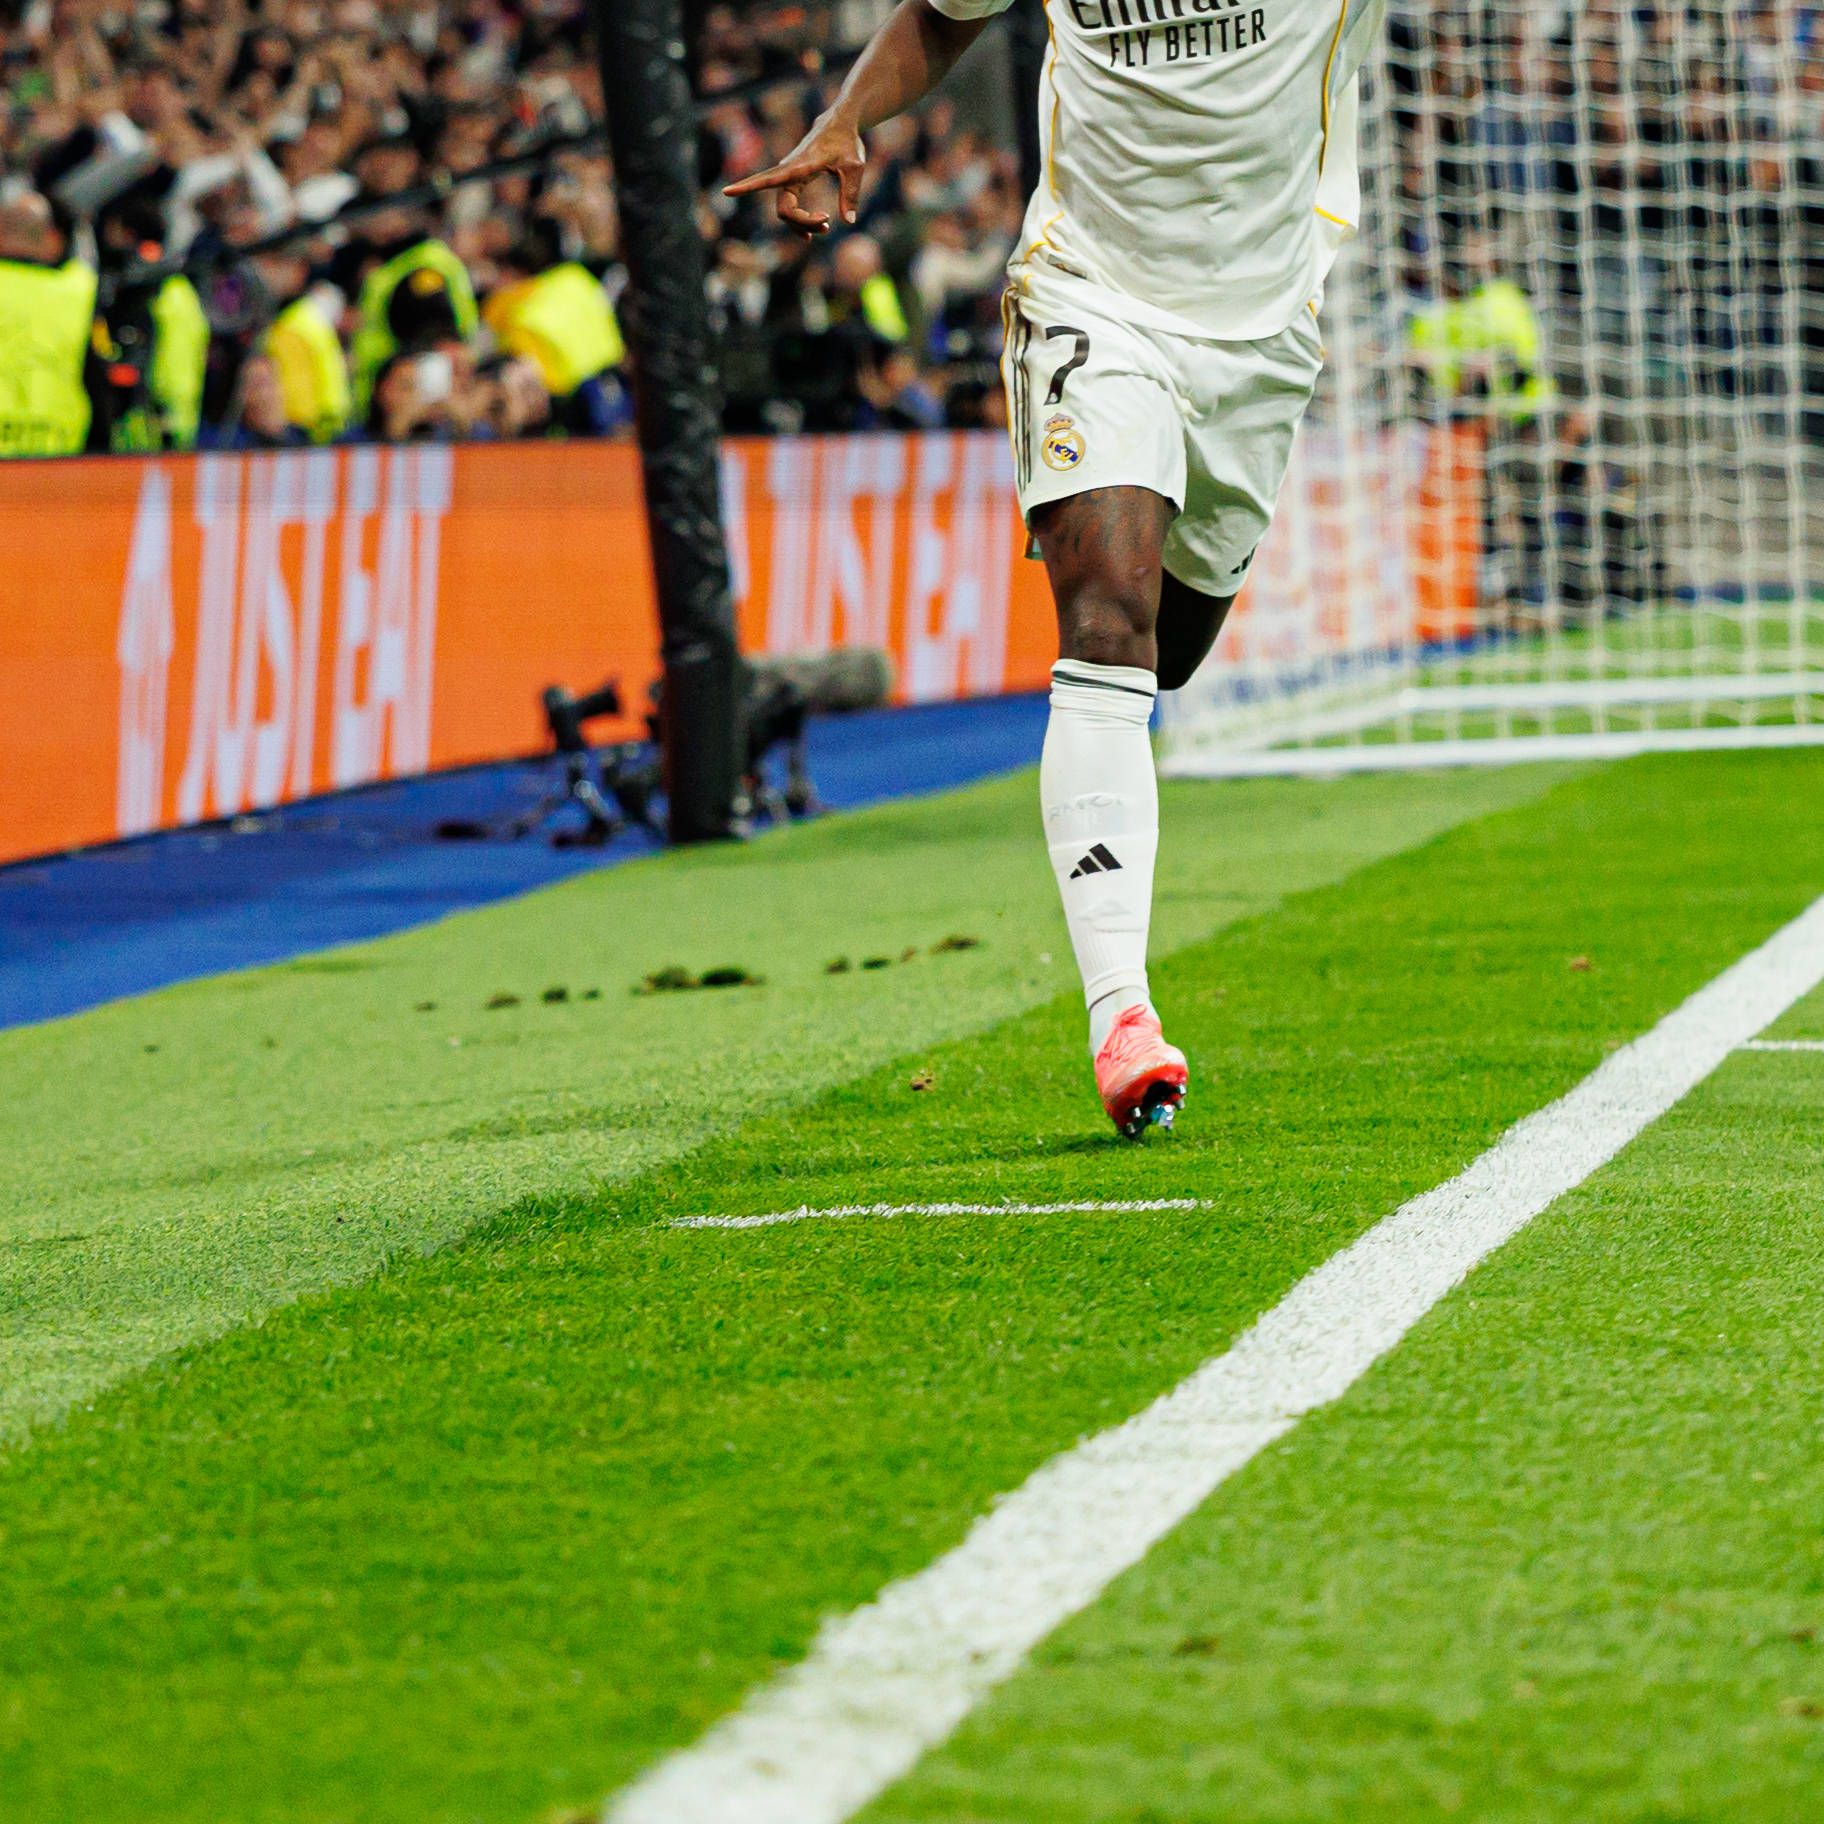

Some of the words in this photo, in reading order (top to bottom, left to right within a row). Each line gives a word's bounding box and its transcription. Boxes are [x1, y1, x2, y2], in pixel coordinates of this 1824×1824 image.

[1107, 28, 1152, 68] FLY
[1164, 8, 1267, 62] BETTER
[1043, 325, 1091, 407] 7
[180, 448, 339, 823] JUST
[330, 443, 453, 788] EAT
[904, 428, 1014, 704] EAT
